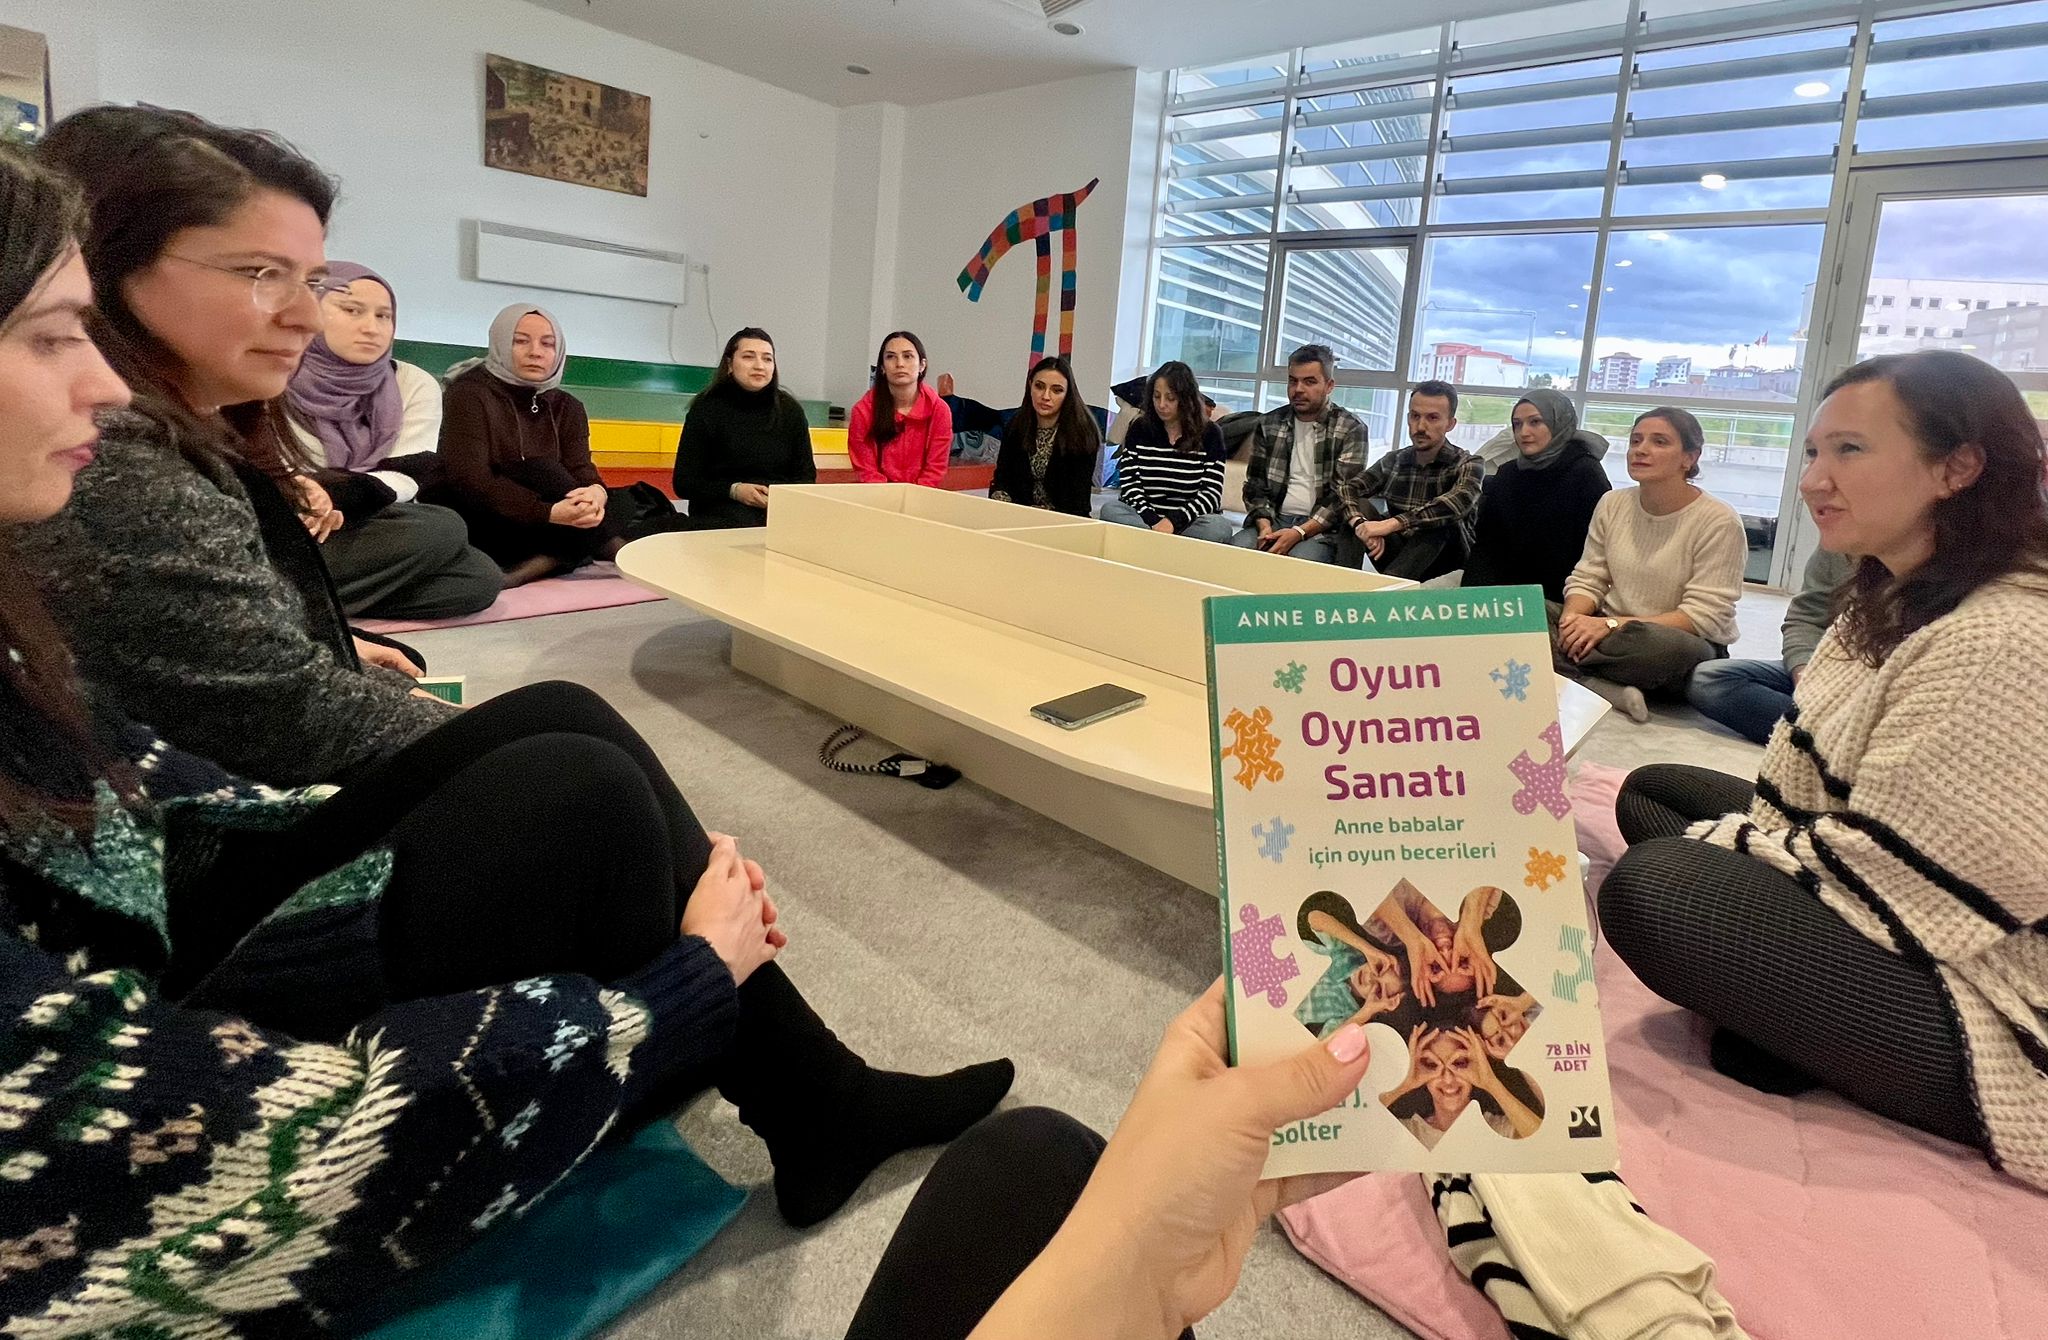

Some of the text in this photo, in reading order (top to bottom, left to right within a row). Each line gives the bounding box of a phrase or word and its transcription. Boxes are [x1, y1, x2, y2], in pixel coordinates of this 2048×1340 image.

[1237, 596, 1525, 628] ANNE BABA AKADEMİSİ
[1329, 657, 1441, 700] Oyun
[1301, 711, 1481, 755] Oynama
[1323, 764, 1467, 801] Sanatı
[1334, 816, 1465, 835] Anne babalar
[1309, 842, 1497, 869] için oyun becerileri
[1545, 1040, 1591, 1056] 78 BİN
[1553, 1060, 1588, 1072] ADET
[1272, 1120, 1342, 1146] Solter
